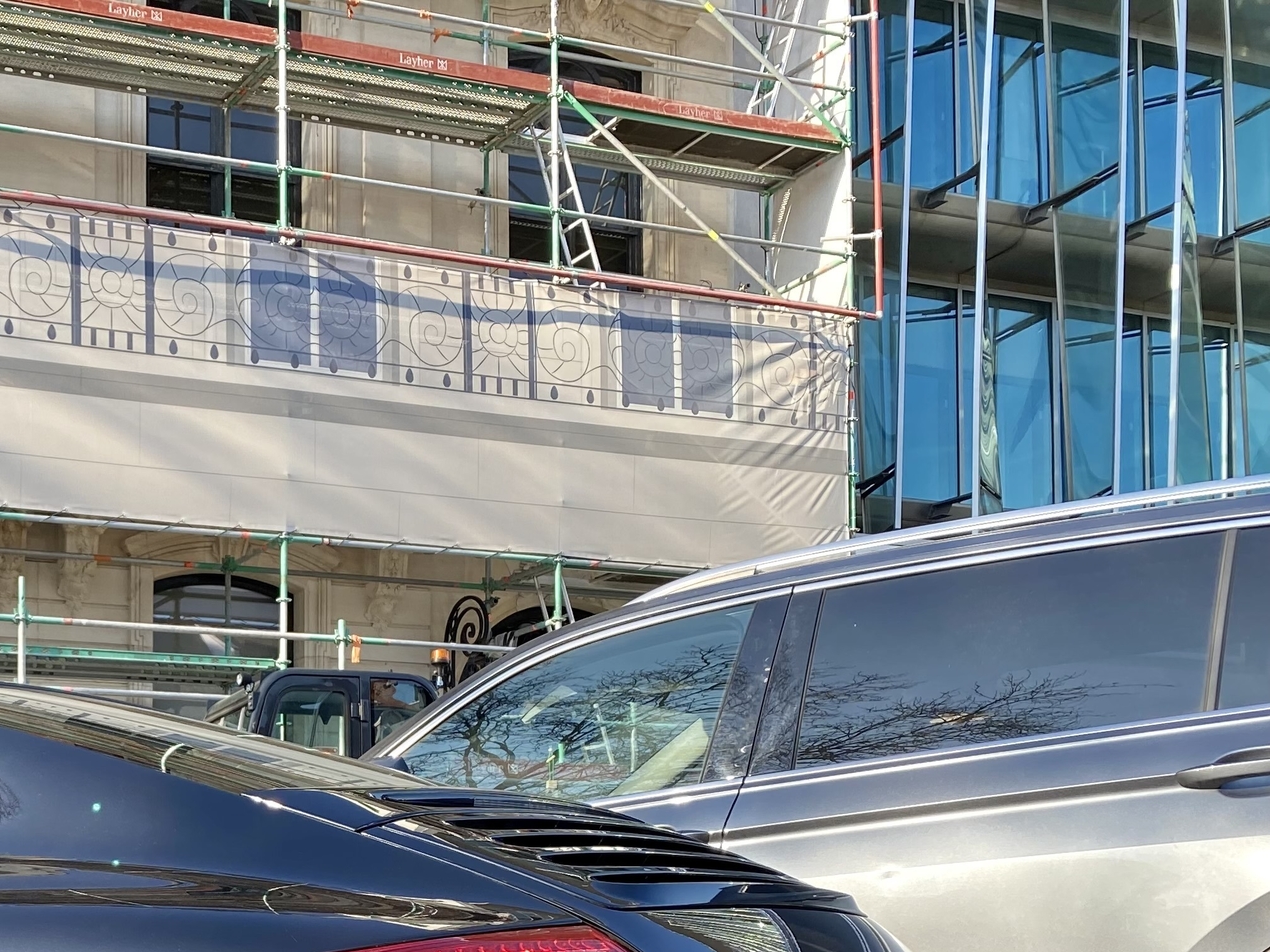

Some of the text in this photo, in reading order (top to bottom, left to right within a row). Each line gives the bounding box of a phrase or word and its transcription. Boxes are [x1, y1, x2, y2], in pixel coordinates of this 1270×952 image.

[108, 2, 148, 19] Layher
[399, 52, 434, 69] Layher
[678, 104, 711, 119] Layher
